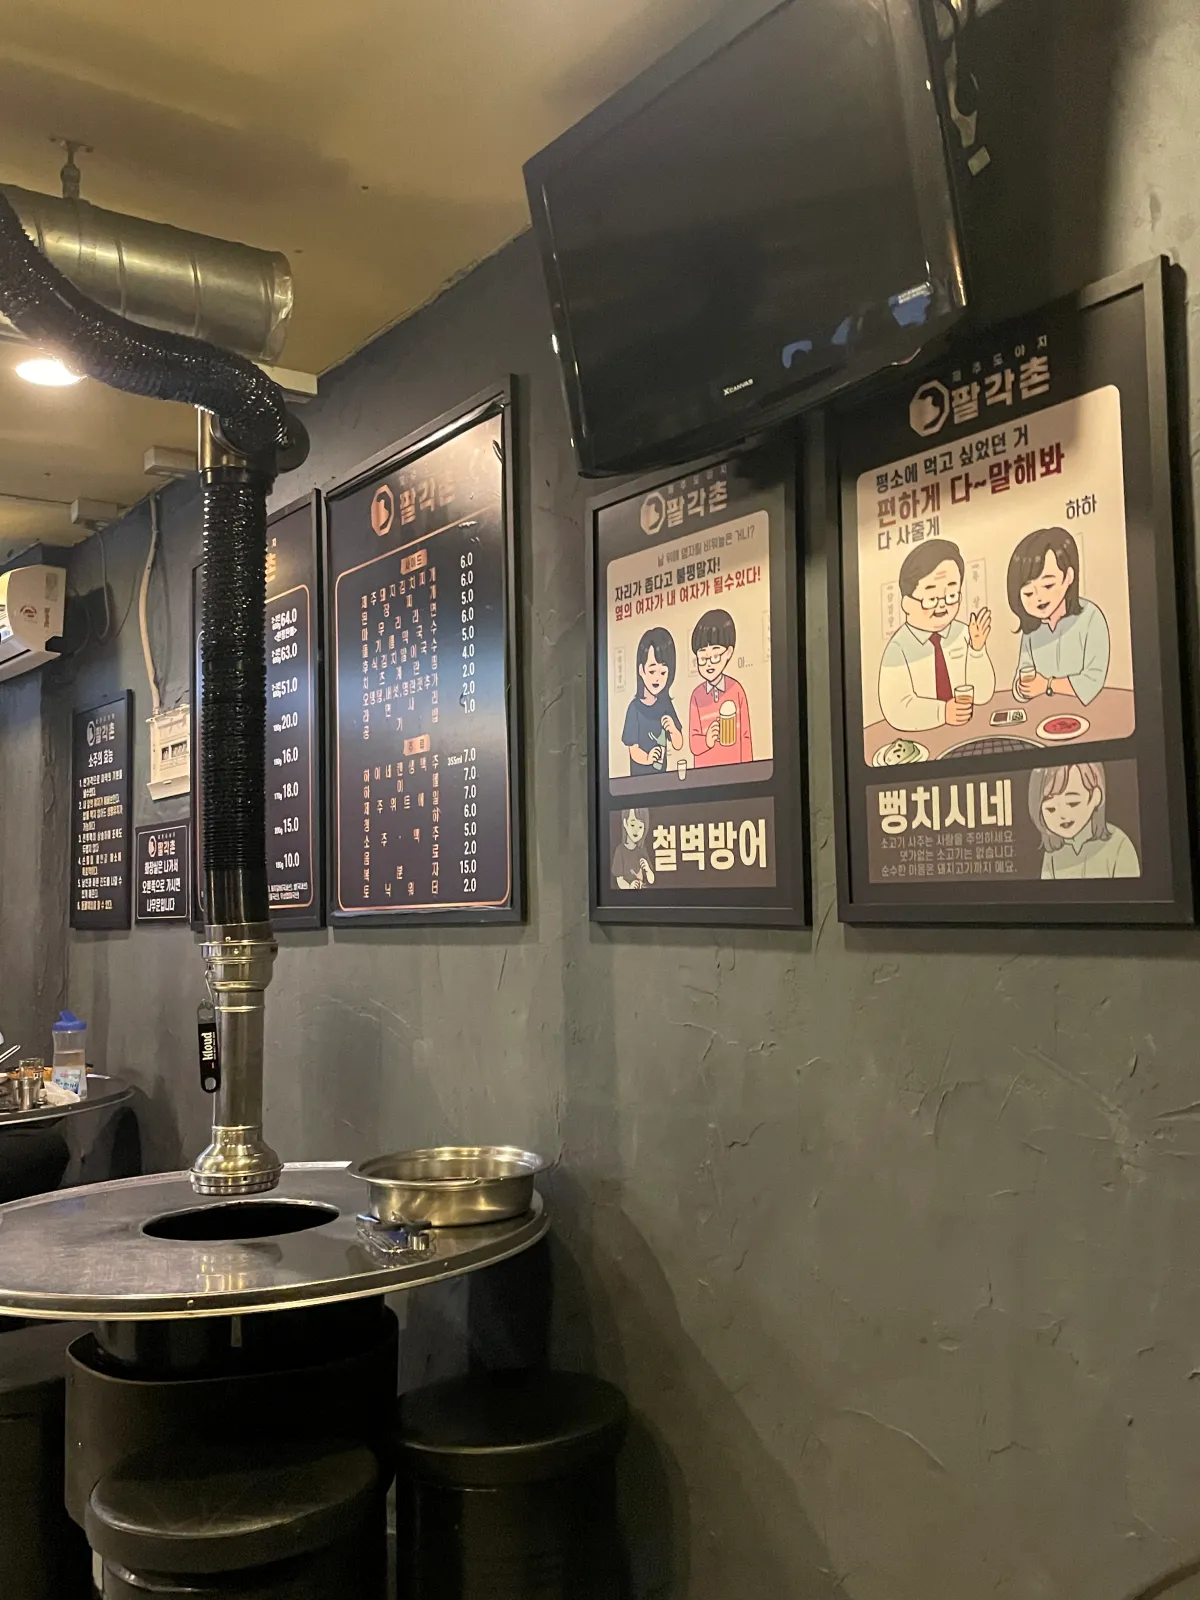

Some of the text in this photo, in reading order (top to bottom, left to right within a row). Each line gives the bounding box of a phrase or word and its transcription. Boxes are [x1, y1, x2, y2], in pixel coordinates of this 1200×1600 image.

[952, 356, 1050, 424] 팔각촌
[876, 424, 1028, 494] 평소에 먹고 싶었던 거
[667, 481, 727, 527] 팔각촌
[877, 482, 941, 528] 편하게
[1065, 494, 1098, 520] 하하
[877, 516, 940, 551] 다 사줄게
[461, 552, 473, 568] 6.0
[461, 570, 473, 587] 6.0
[615, 580, 642, 602] 자리가
[645, 571, 673, 594] 좁다고
[461, 588, 473, 605] 5.0
[615, 602, 632, 621] 옆의
[635, 594, 663, 615] 여자가
[666, 589, 676, 606] 내
[679, 580, 710, 603] 여자가
[281, 608, 298, 628] 64.0
[461, 607, 474, 623] 6.0
[462, 625, 474, 641] 5.0
[281, 643, 298, 661] 63.0
[462, 643, 475, 659] 4.0
[462, 662, 475, 678] 2.0
[281, 677, 298, 696] 51.0
[463, 680, 475, 696] 2.0
[464, 699, 475, 713] 1.0
[281, 712, 298, 730] 20.0
[88, 751, 102, 767] 소주의
[282, 747, 298, 763] 16.0
[463, 747, 476, 762] 7.0
[463, 765, 476, 780] 7.0
[283, 782, 298, 798] 18.0
[463, 784, 476, 799] 7.0
[464, 803, 476, 818] 6.0
[879, 779, 1012, 834] 뻥치시네
[283, 817, 299, 833] 15.0
[464, 822, 476, 837] 5.0
[464, 840, 476, 855] 2.0
[653, 819, 767, 872] 철벽방어
[881, 836, 905, 849] 소고기
[908, 835, 934, 848] 사주는
[284, 852, 300, 868] 10.0
[937, 847, 972, 860] 소고기는
[460, 859, 476, 874] 15.0
[463, 878, 476, 892] 2.0
